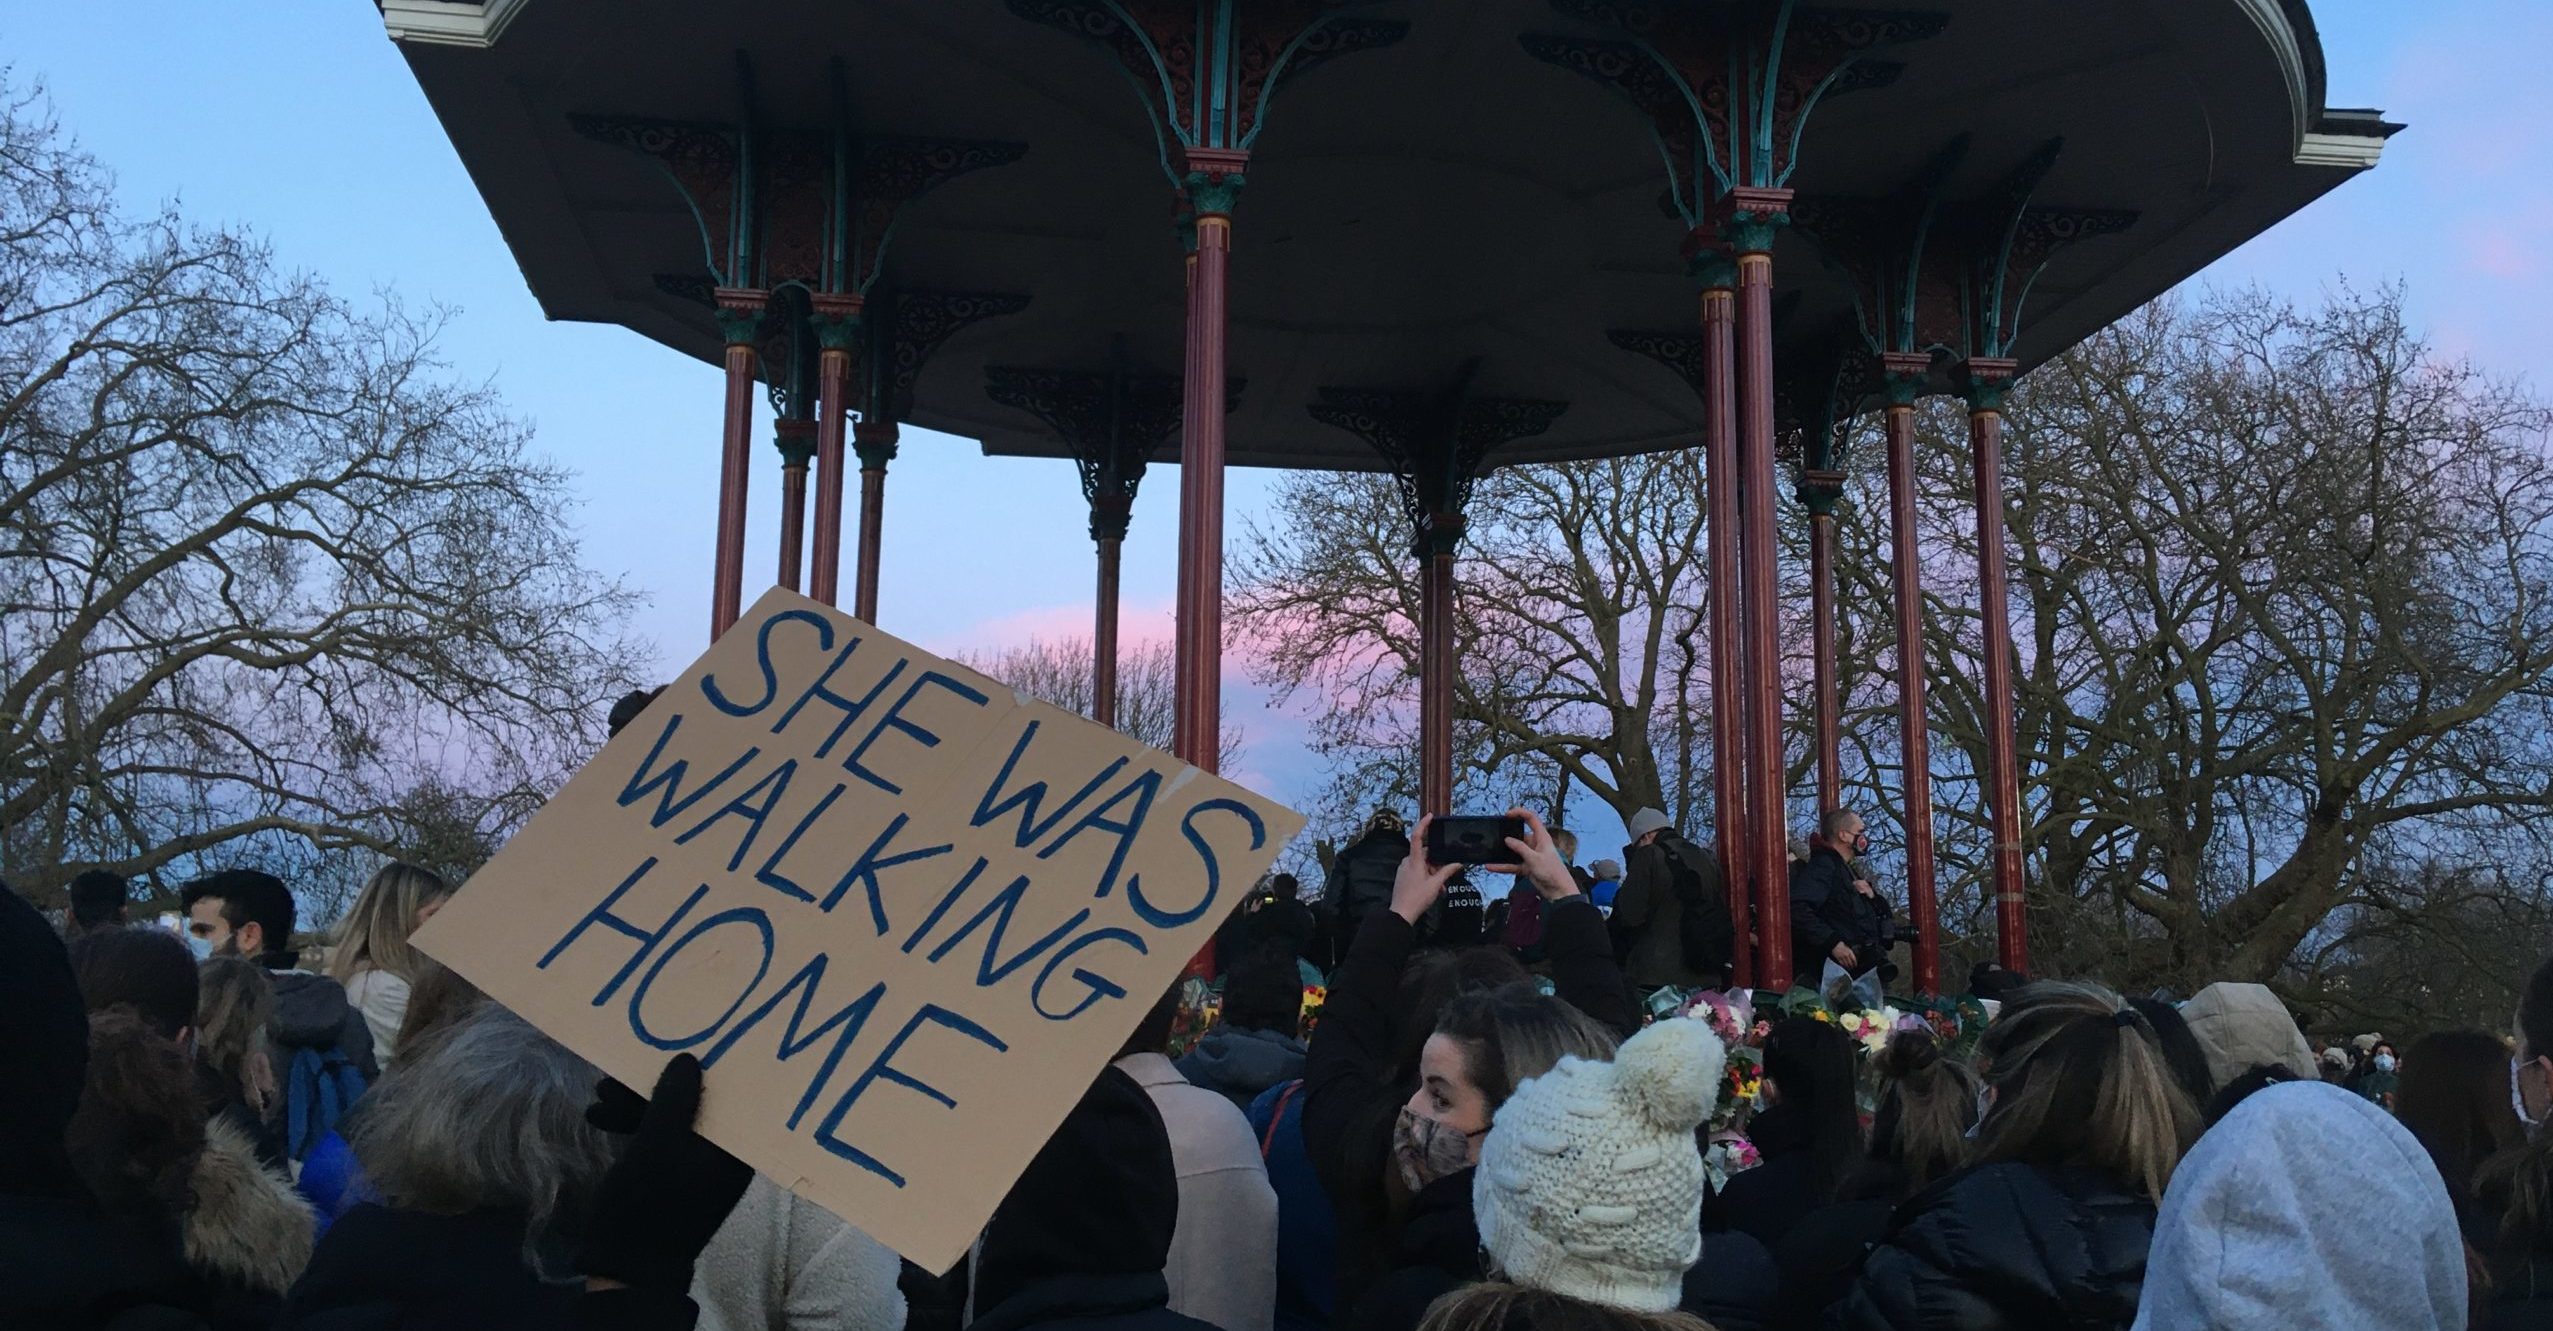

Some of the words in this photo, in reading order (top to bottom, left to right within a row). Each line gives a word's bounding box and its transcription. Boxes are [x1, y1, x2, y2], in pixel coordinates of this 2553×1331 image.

[616, 714, 1149, 1022] WALKING
[700, 610, 989, 797] SHE
[971, 720, 1266, 929] WAS
[536, 856, 1009, 1190] HOME
